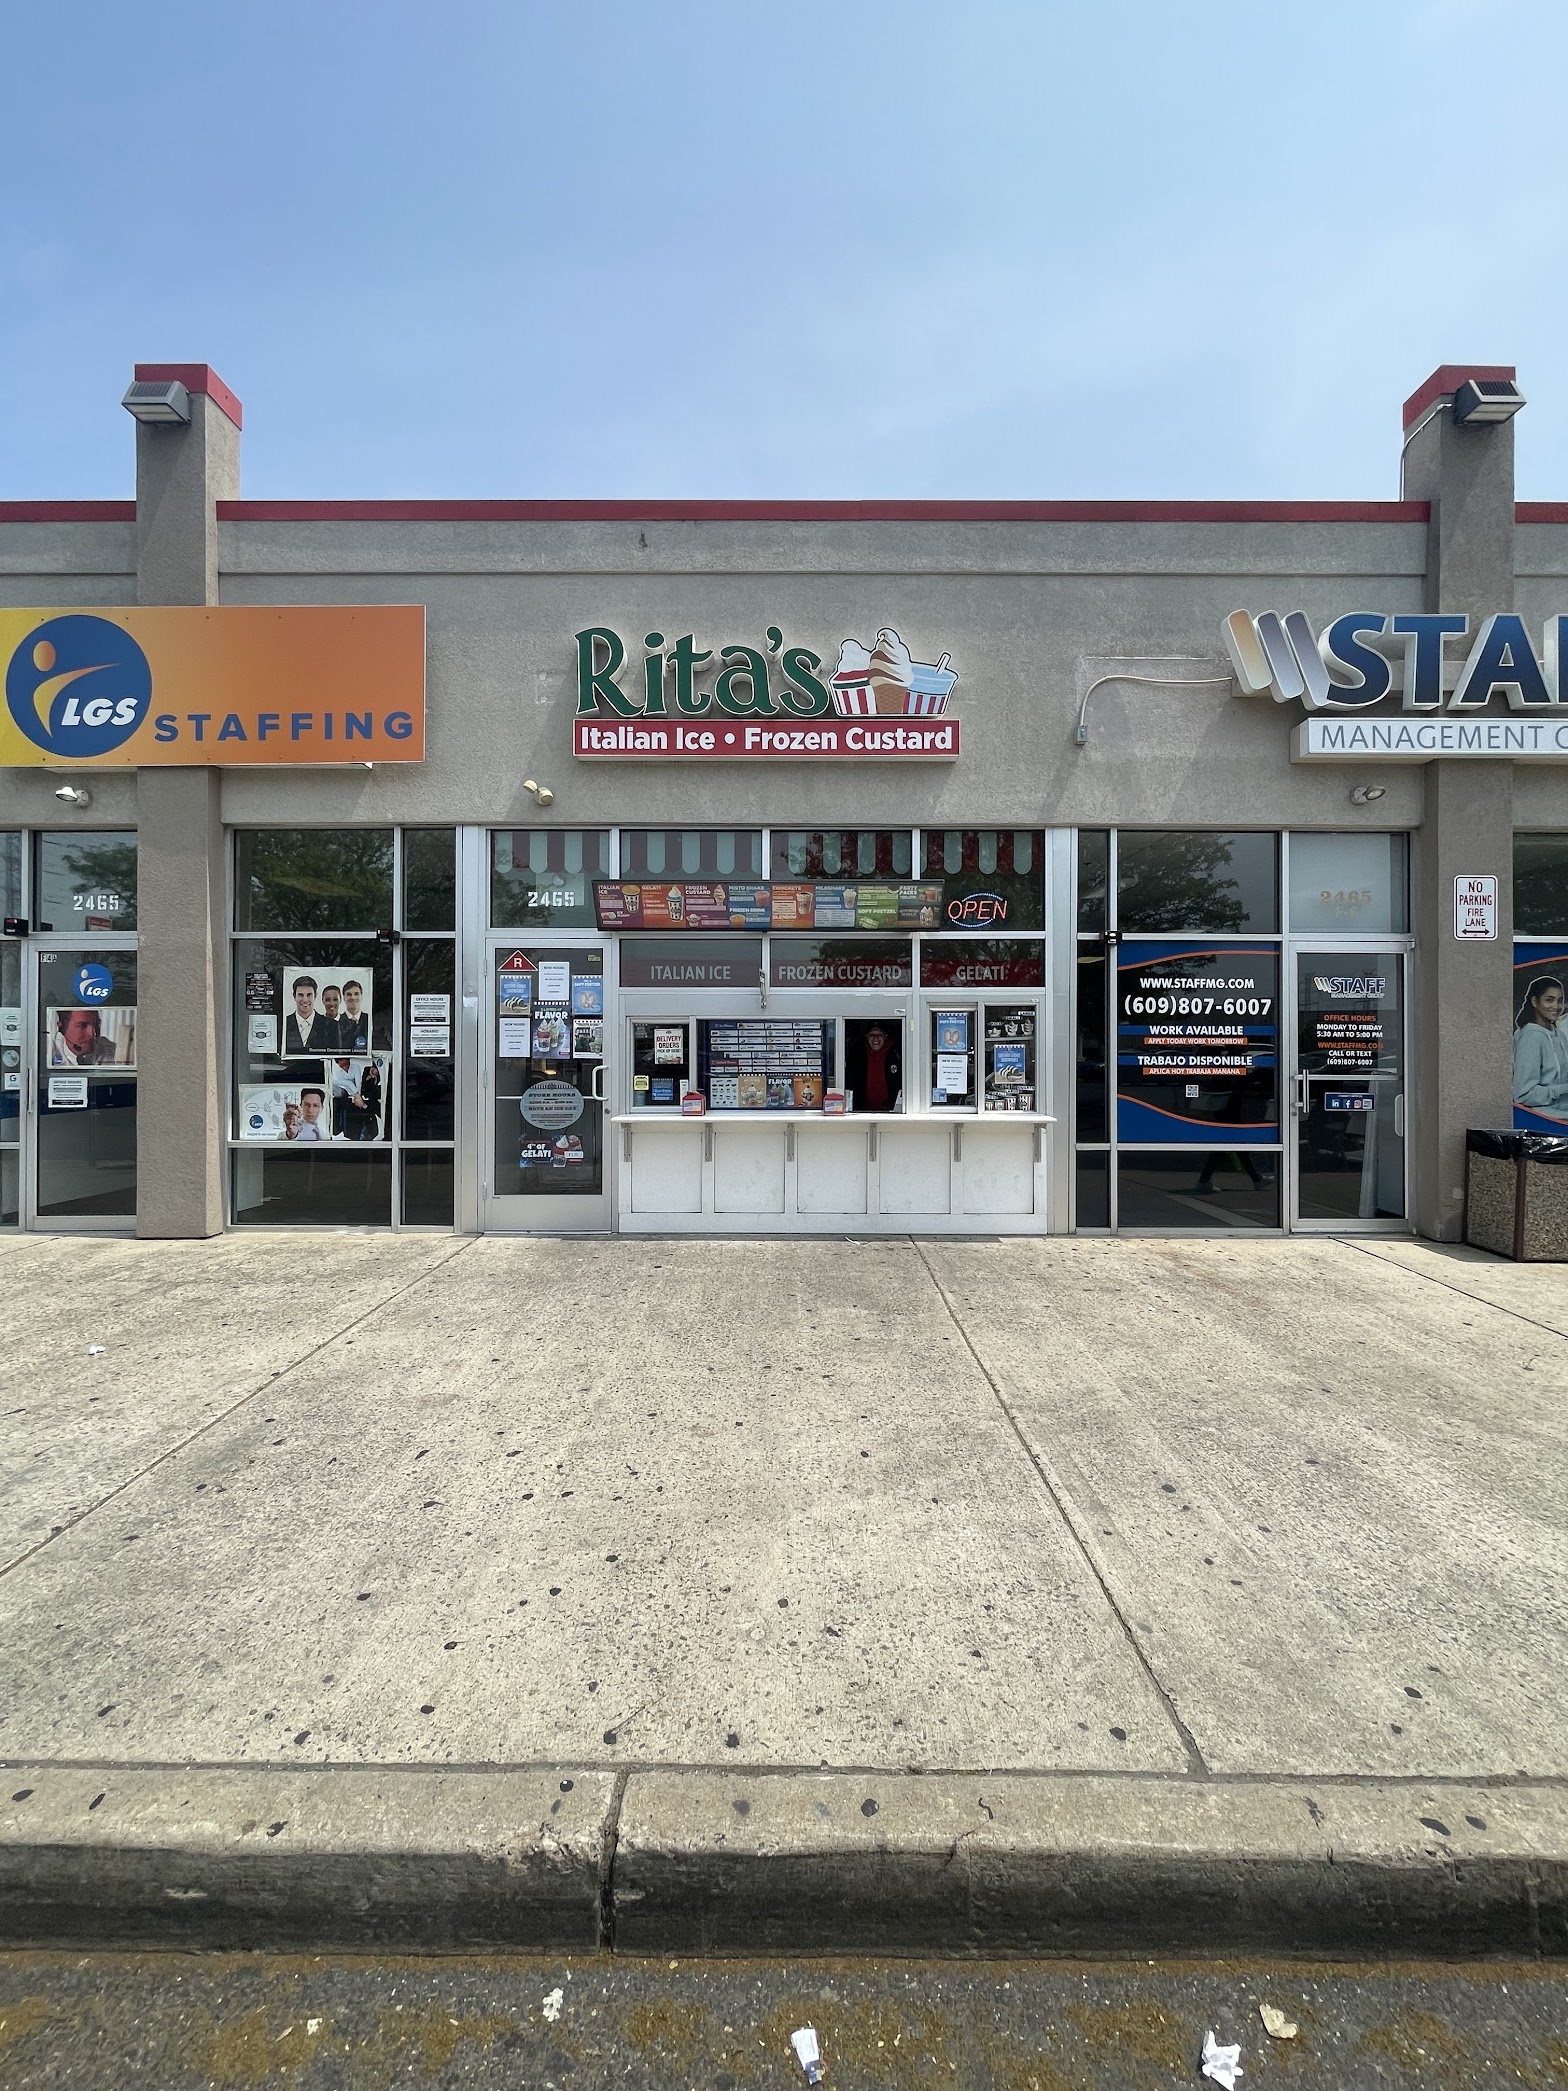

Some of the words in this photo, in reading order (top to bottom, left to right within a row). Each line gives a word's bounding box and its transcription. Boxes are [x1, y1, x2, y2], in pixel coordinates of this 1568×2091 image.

[573, 626, 830, 717] Rita's
[61, 698, 138, 727] LGS
[154, 711, 414, 743] STAFFING
[581, 726, 668, 750] Italian
[676, 726, 715, 750] Ice
[745, 727, 838, 750] Frozen
[845, 727, 953, 750] Custard
[1322, 725, 1545, 749] MANAGEMENT
[1468, 881, 1483, 893] NO
[73, 895, 119, 911] 2465
[527, 891, 575, 907] 2465
[1320, 890, 1373, 905] 2465
[1459, 894, 1493, 906] PARKING
[947, 900, 1008, 920] OPEN
[1467, 907, 1484, 917] FIRE
[1465, 918, 1486, 927] LANE
[513, 957, 523, 968] R
[651, 965, 705, 980] ITALIAN
[709, 965, 731, 980] ICE
[778, 966, 834, 980] FROZEN
[837, 966, 902, 980] CUSTARD
[955, 965, 1005, 980] GELATI
[1139, 977, 1255, 989] WWW.STAFFMG.COM
[1329, 977, 1386, 994] STAFF
[86, 986, 109, 997] LGS
[1124, 995, 1272, 1016] (609)807-6007
[534, 1011, 568, 1019] FLAVOR
[1149, 1025, 1183, 1036] WORK
[1185, 1025, 1244, 1036] AVAILABLE
[1317, 1041, 1385, 1049] WWW.STAFFMG.COM
[1138, 1055, 1186, 1066] TRABAJO
[1189, 1055, 1253, 1066] DISPONIBLE
[1327, 1058, 1374, 1066] (609)807-6007
[1149, 1067, 1170, 1075] APLICA
[1171, 1067, 1185, 1075] HOY
[1186, 1067, 1211, 1075] TRABAJA
[521, 1149, 552, 1158] GELATI
